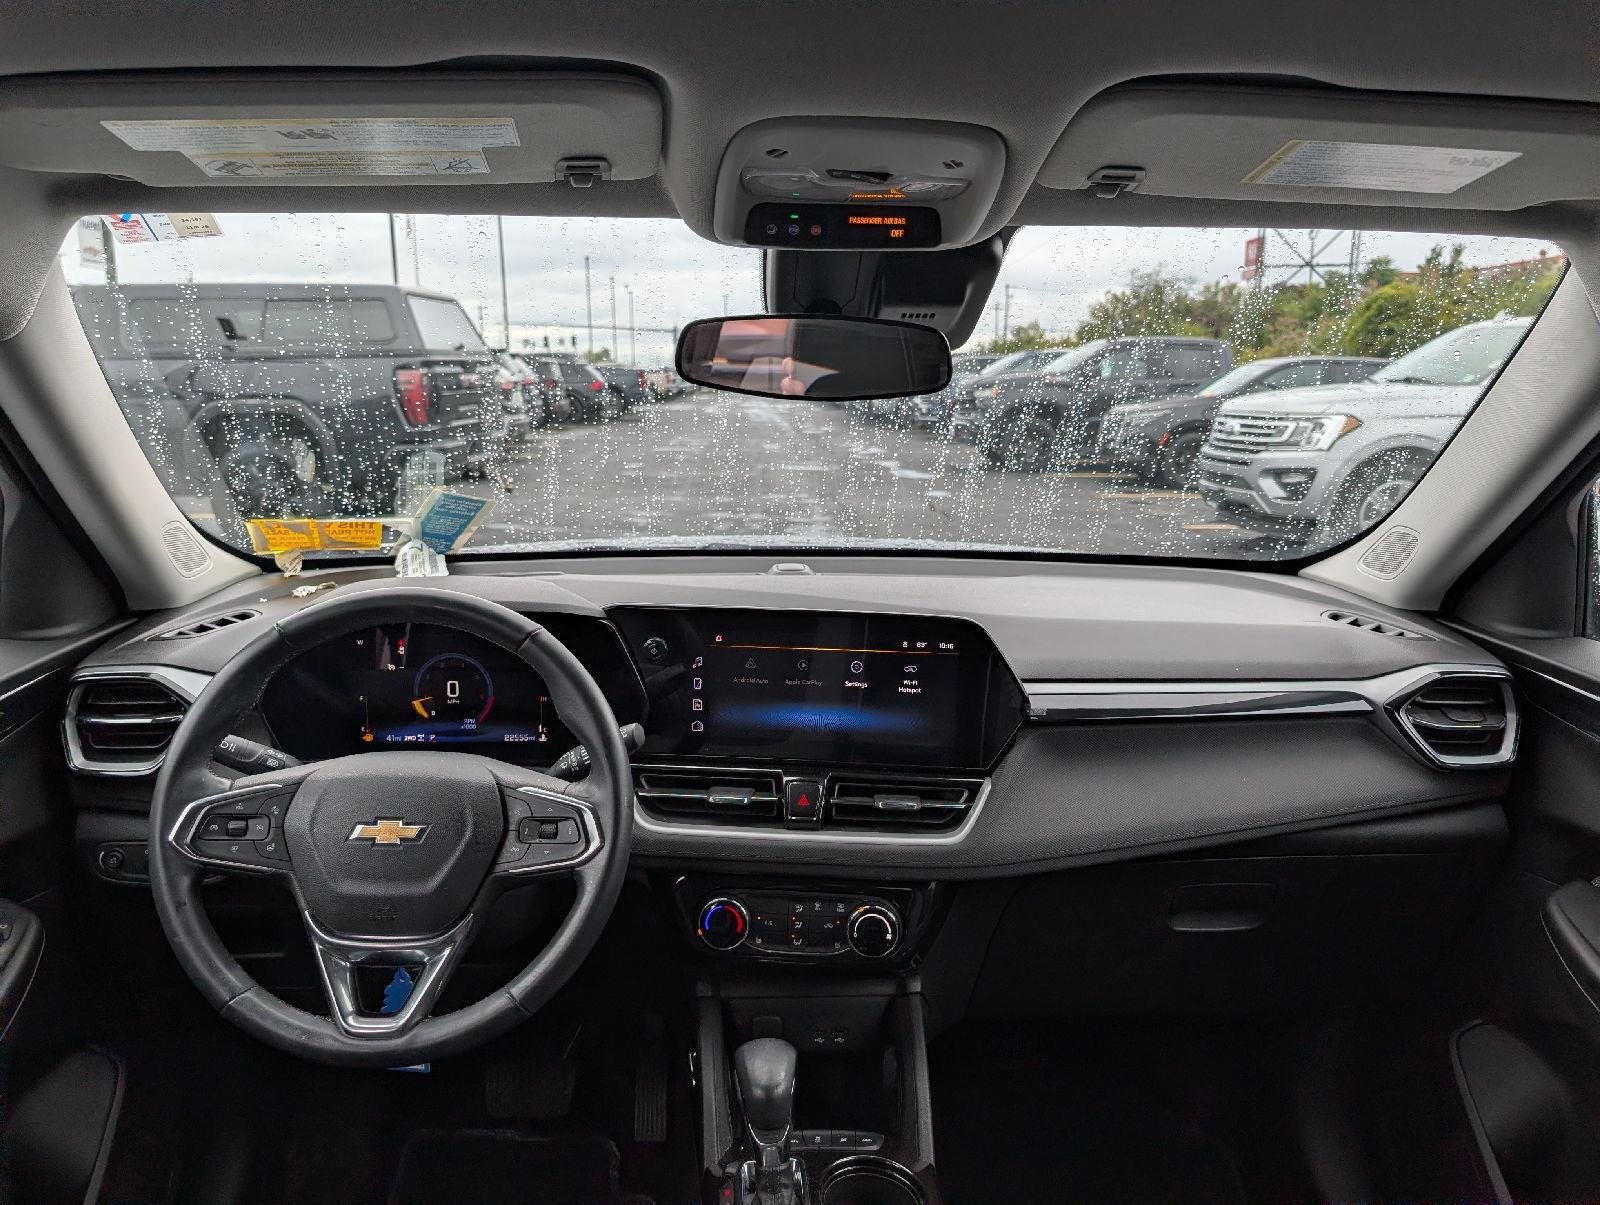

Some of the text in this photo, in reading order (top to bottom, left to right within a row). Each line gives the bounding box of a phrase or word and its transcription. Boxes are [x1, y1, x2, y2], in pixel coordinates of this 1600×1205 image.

[849, 216, 906, 225] PASSENGER AIRBAG
[890, 229, 905, 238] OFF
[785, 677, 823, 687] Apple CarPlay
[844, 680, 868, 688] Settings
[446, 680, 460, 698] 0
[898, 686, 922, 694] Hotspot
